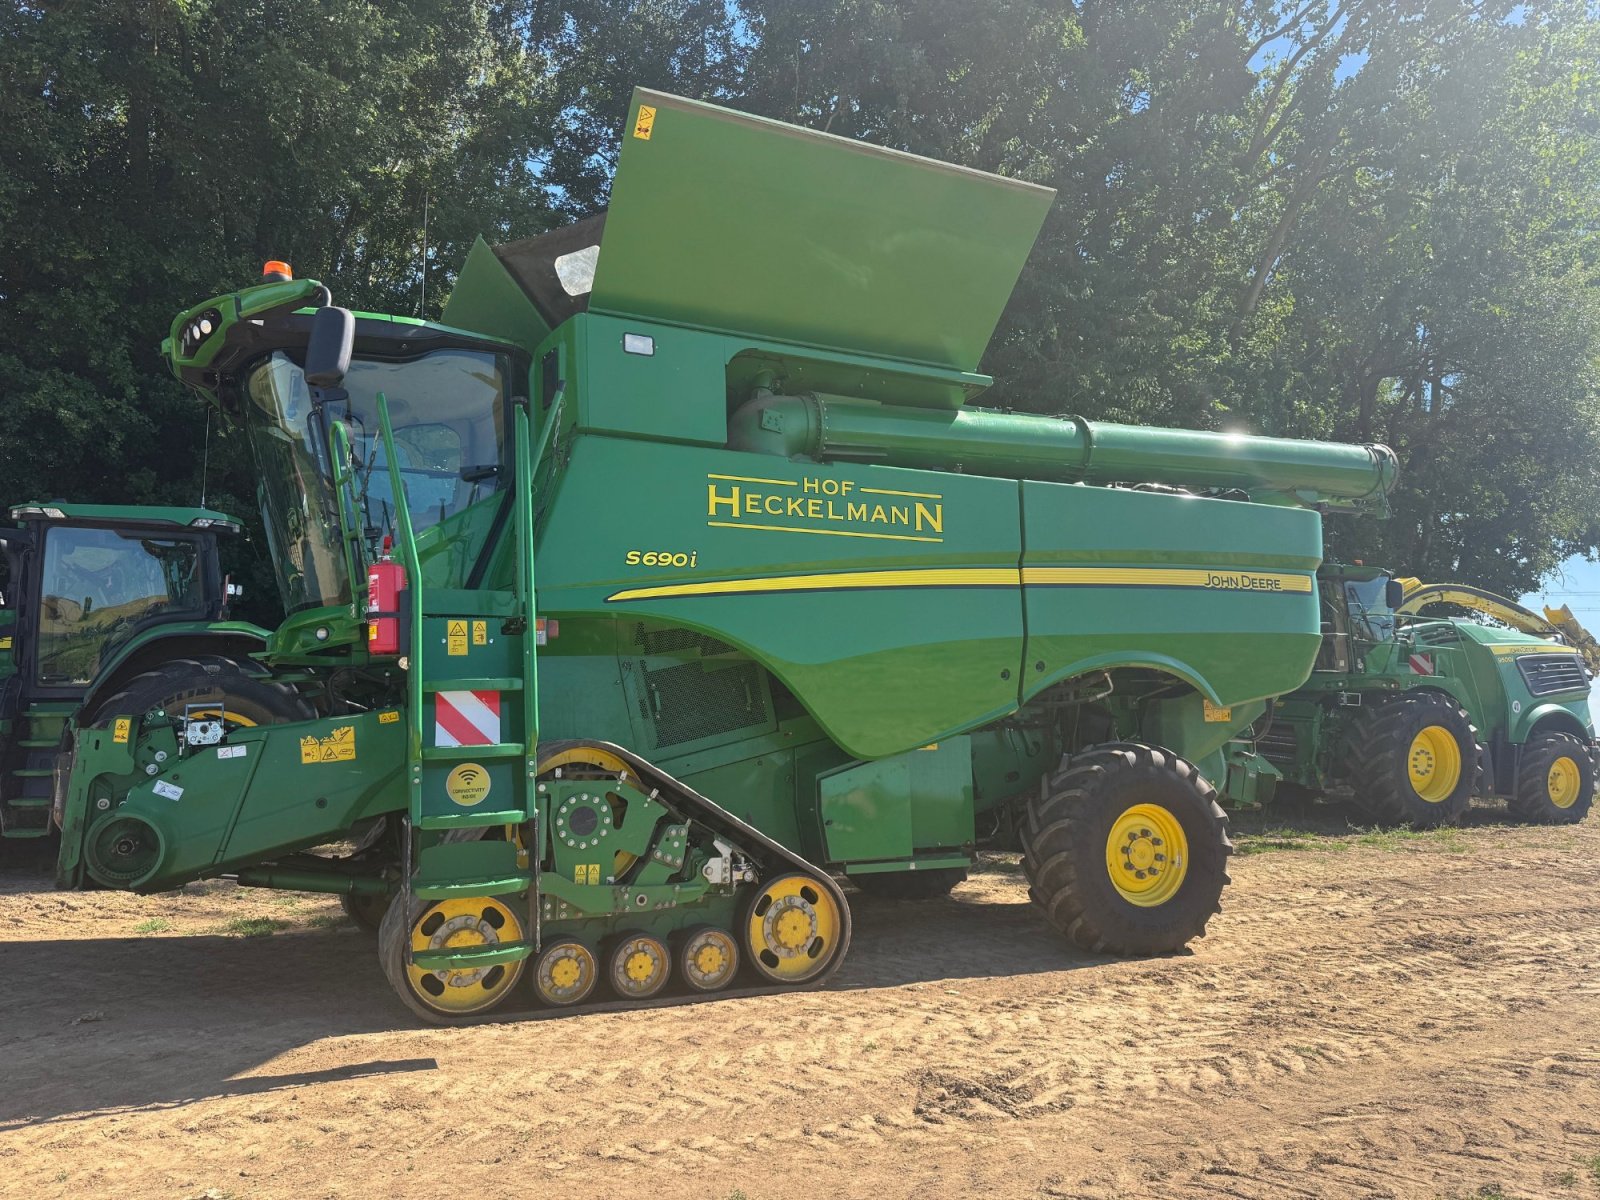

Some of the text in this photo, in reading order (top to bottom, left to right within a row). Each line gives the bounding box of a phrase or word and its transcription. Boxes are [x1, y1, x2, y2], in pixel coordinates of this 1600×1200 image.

[803, 477, 855, 496] HOF
[707, 484, 944, 533] HECKELMANN
[625, 549, 698, 568] S690i
[1204, 573, 1282, 590] JOHN DEERE
